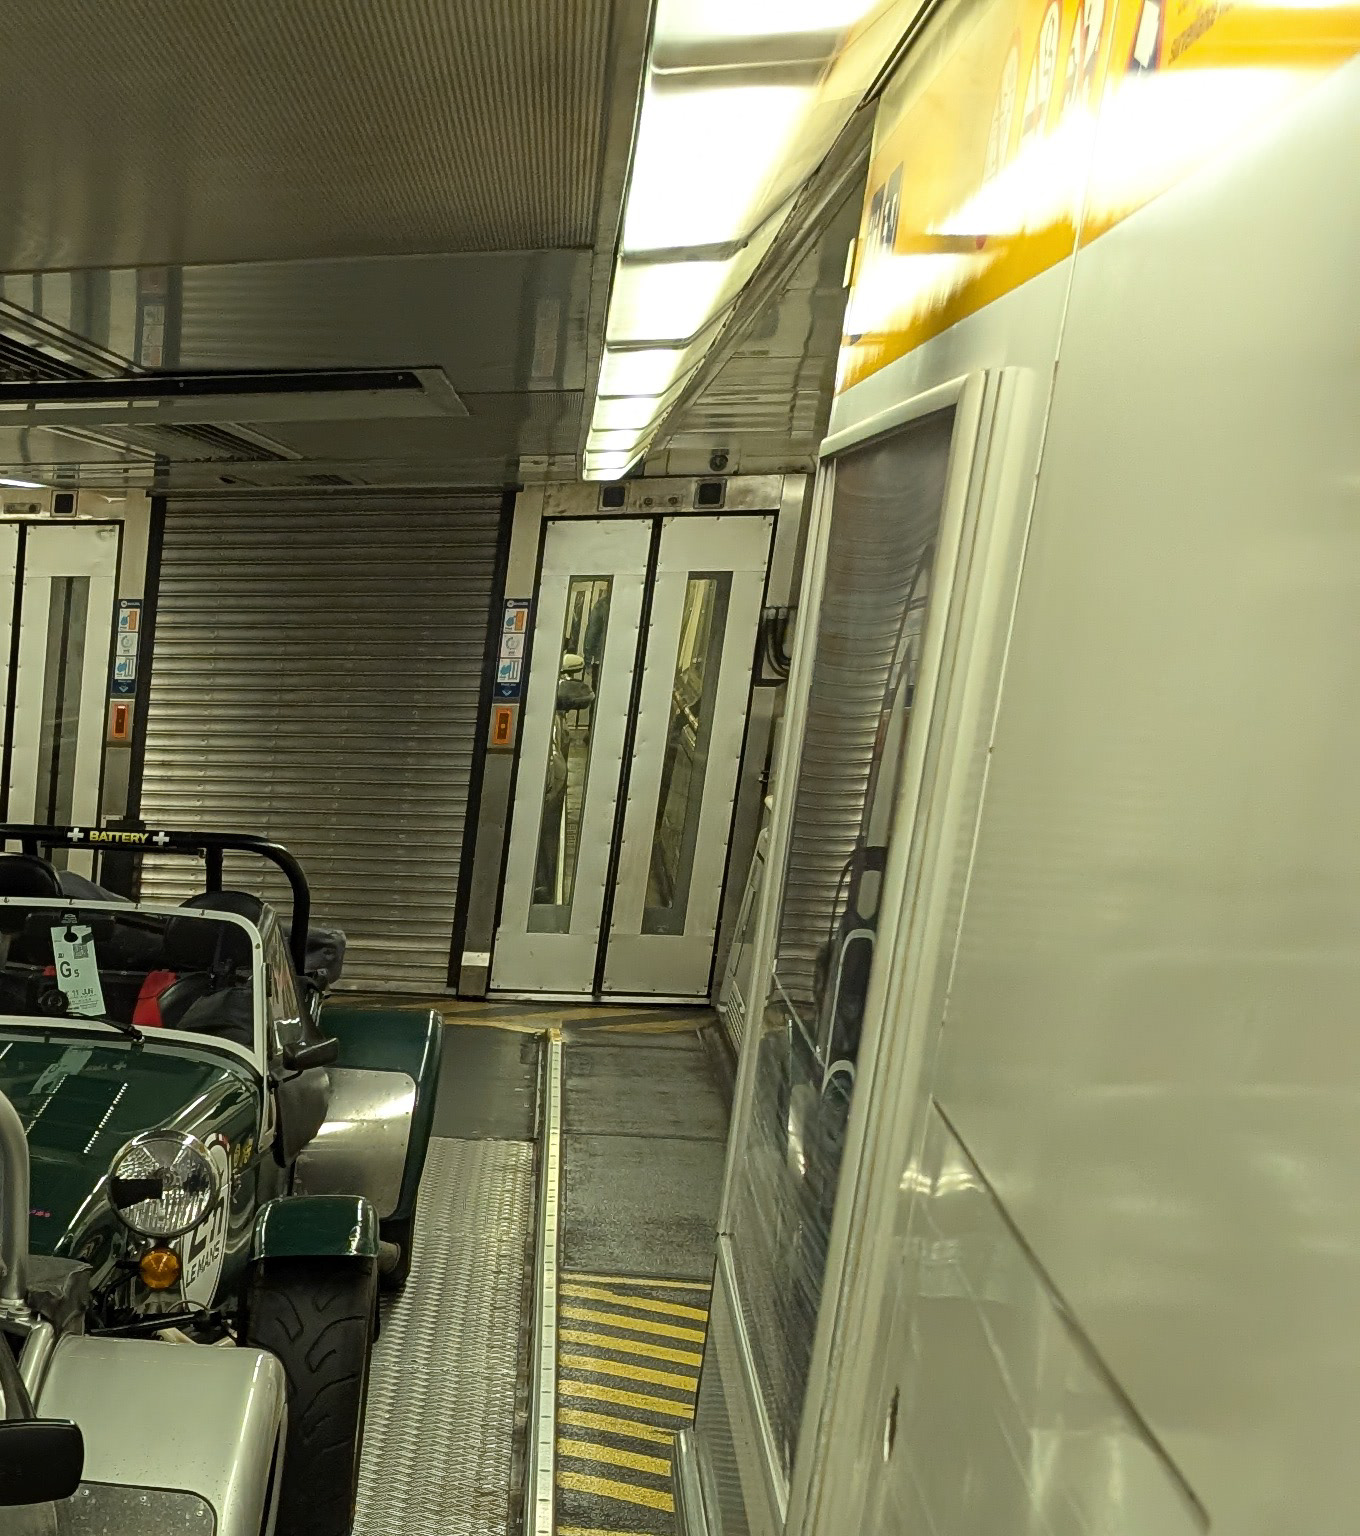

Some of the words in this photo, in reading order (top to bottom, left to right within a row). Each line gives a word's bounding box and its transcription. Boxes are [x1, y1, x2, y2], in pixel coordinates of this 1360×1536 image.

[89, 830, 149, 844] BATTERY
[59, 960, 71, 978] G
[185, 1262, 197, 1288] LE
[197, 1240, 221, 1277] MANS
